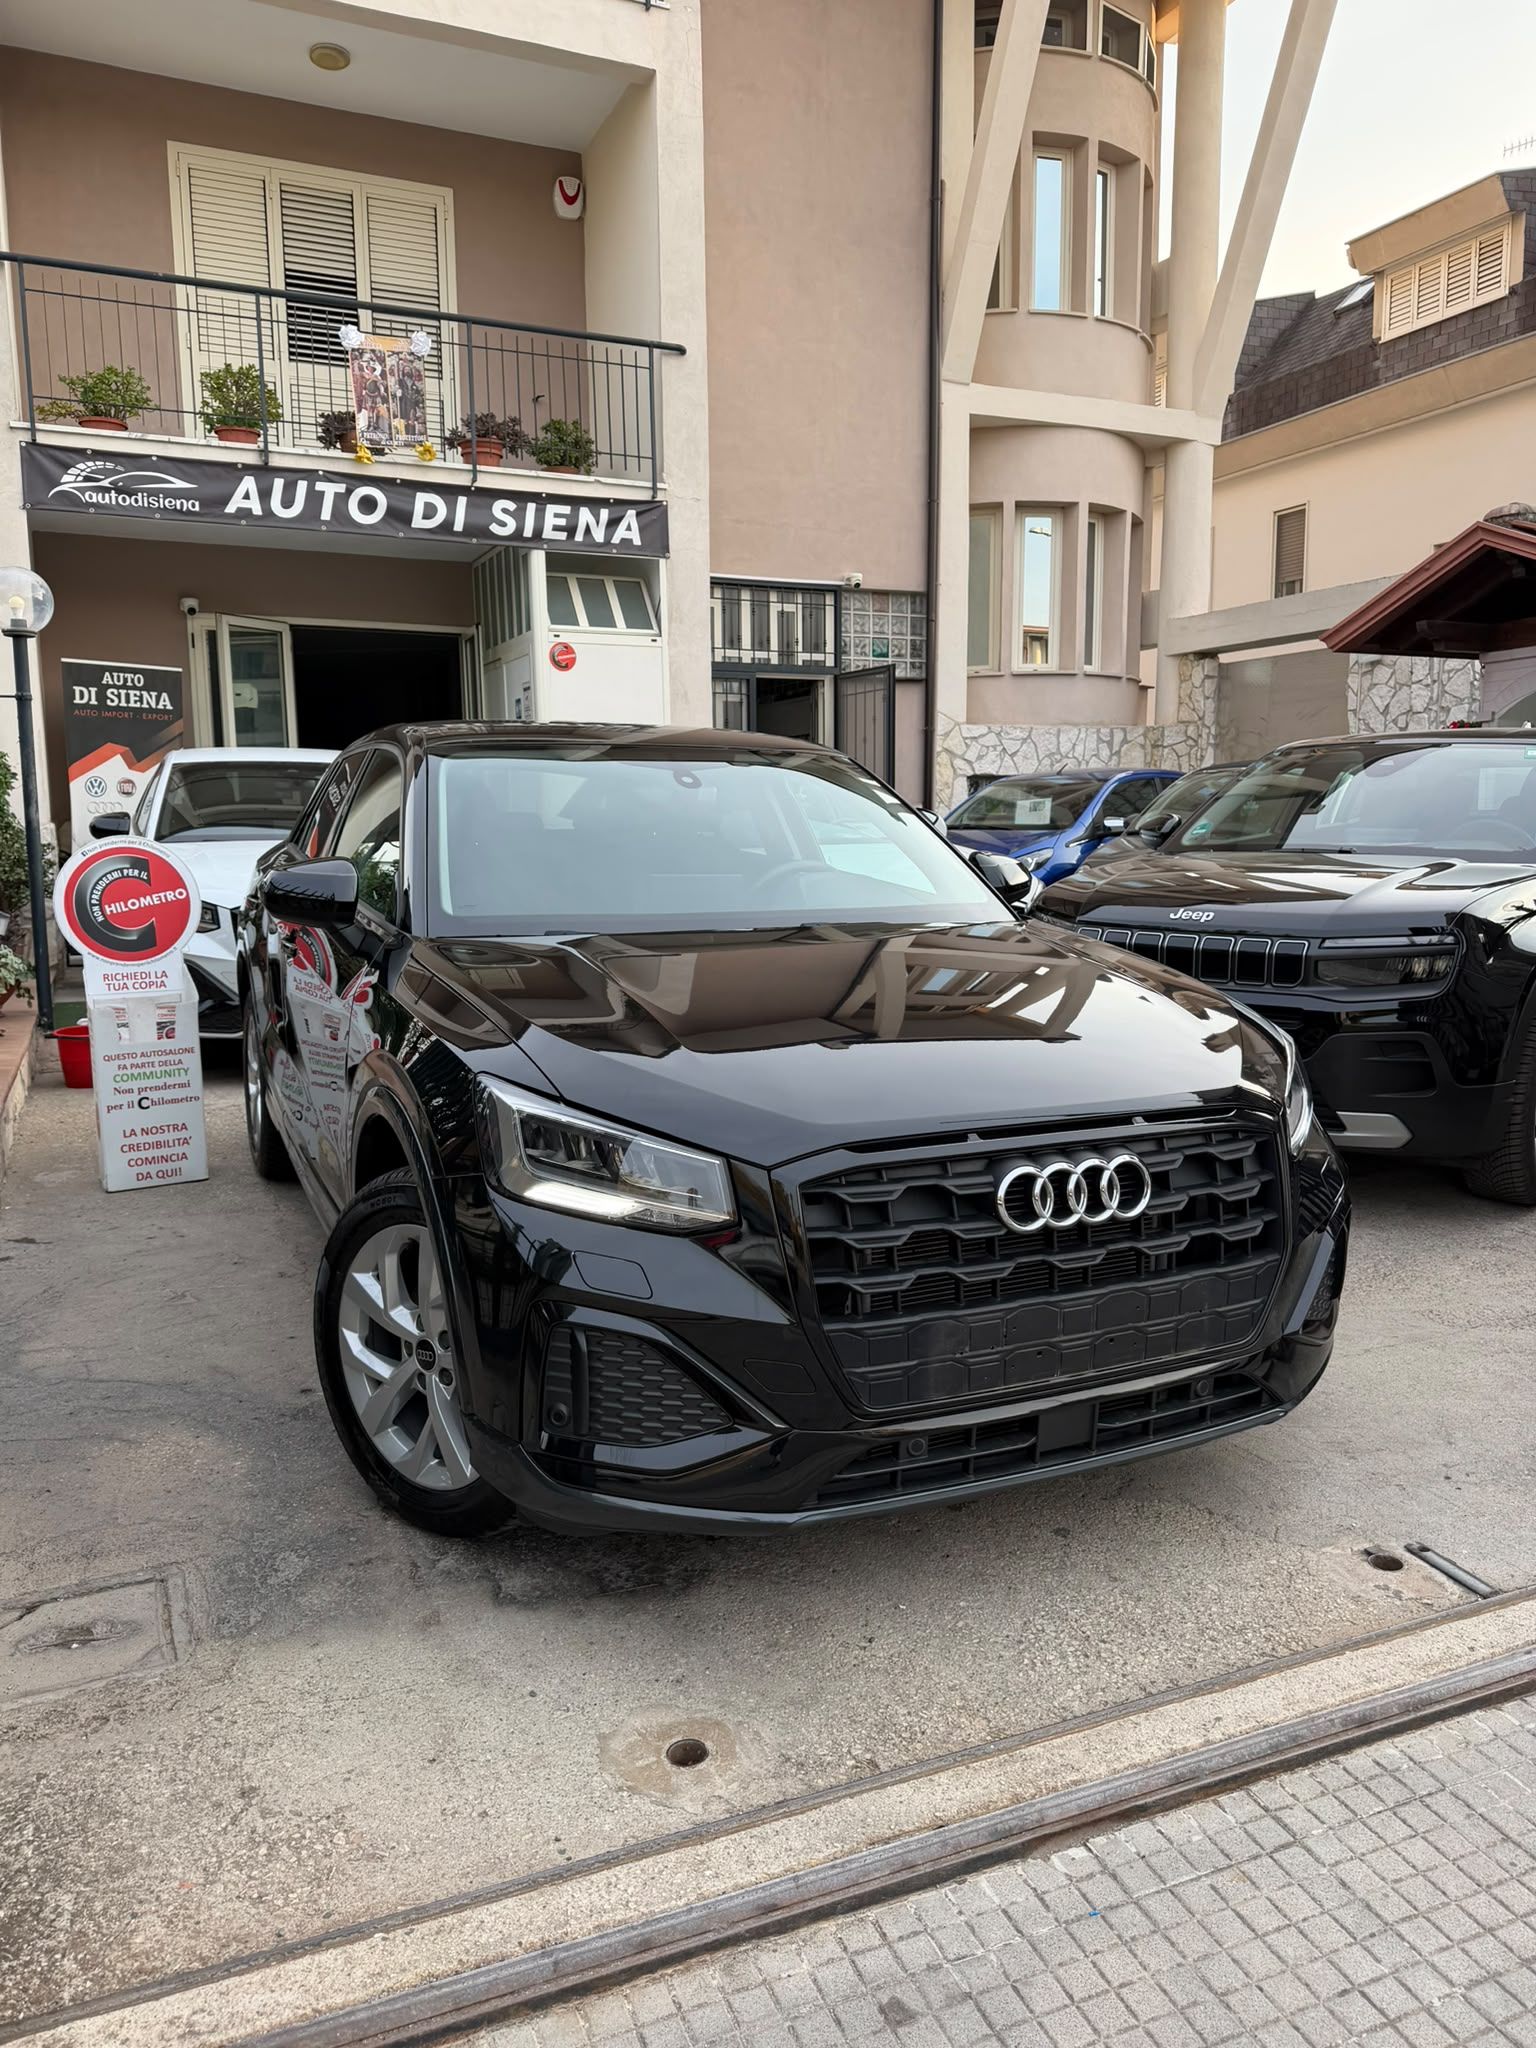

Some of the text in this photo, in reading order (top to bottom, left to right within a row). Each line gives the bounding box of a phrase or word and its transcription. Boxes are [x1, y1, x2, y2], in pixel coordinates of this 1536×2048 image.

[84, 490, 200, 512] autodisiena
[224, 475, 642, 546] AUTO DI SIENA
[101, 672, 144, 687] AUTO
[72, 686, 174, 710] DI SIENA
[73, 709, 98, 717] AUTO
[101, 710, 133, 719] IMPORT
[142, 712, 173, 720] EXPORT
[91, 868, 148, 922] NON PRENDERMI PER IL
[1170, 908, 1215, 922] Jeep
[102, 970, 168, 982] RICHIEDI LA
[105, 980, 167, 992] TUA COPIA
[103, 1046, 196, 1062] QUESTO AUTOSALONE
[130, 1061, 156, 1070] PARTE
[158, 1058, 184, 1068] DELLA
[112, 1067, 190, 1083] COMMUNITY
[113, 1080, 191, 1096] Non prendermi
[106, 1103, 124, 1114] per
[127, 1100, 134, 1109] il
[122, 1122, 188, 1138] LA NOSTRA
[120, 1136, 192, 1154] CREDIBILITA'
[127, 1152, 188, 1168] COMINCIA
[136, 1167, 182, 1182] DA QUI!
